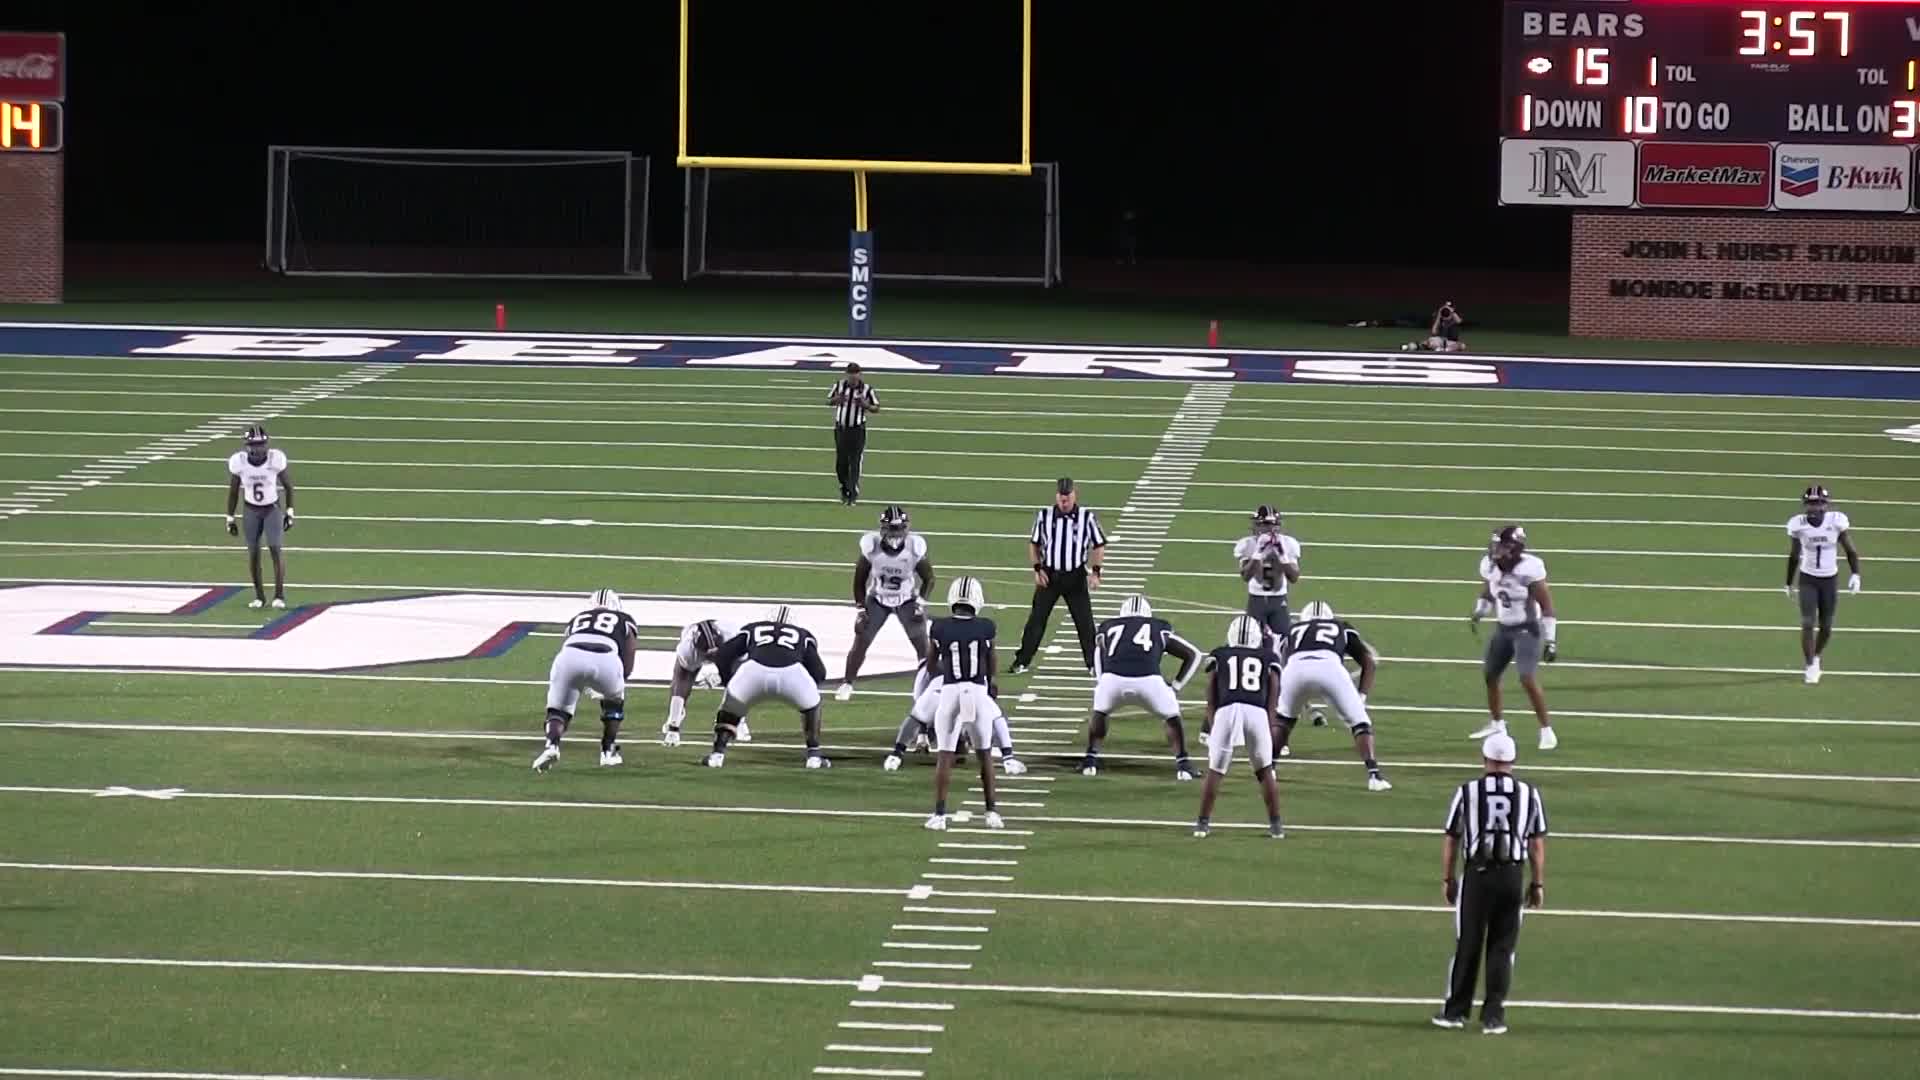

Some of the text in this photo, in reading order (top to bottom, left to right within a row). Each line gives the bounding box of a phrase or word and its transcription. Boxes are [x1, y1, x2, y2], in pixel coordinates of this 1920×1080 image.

[1522, 11, 1645, 38] BEARS
[1739, 10, 1849, 57] 3:57
[1575, 47, 1609, 85] 15
[1650, 56, 1697, 86] 1 TOL
[1857, 68, 1889, 85] TOL
[1522, 94, 1730, 134] 1 DOWN 10 TO GO
[1787, 104, 1849, 132] BALL
[1857, 105, 1890, 132] ON
[1781, 155, 1820, 164] Chevron
[1642, 165, 1766, 185] MarketMax
[1826, 165, 1903, 190] B-Kwik
[1624, 240, 1687, 260] JOHN
[1717, 242, 1793, 262] HURST
[1808, 244, 1916, 264] STADIUM
[1609, 279, 1713, 299] MONROE
[1722, 281, 1848, 302] McELVEEN
[130, 333, 1501, 386] BEARS
[253, 482, 265, 502] 6
[1815, 544, 1822, 570] 1
[753, 624, 800, 650] 52
[1106, 623, 1153, 657] 74
[1291, 621, 1340, 650] 72
[949, 640, 979, 680] 11
[1227, 655, 1263, 692] 18
[1485, 794, 1512, 831] R
